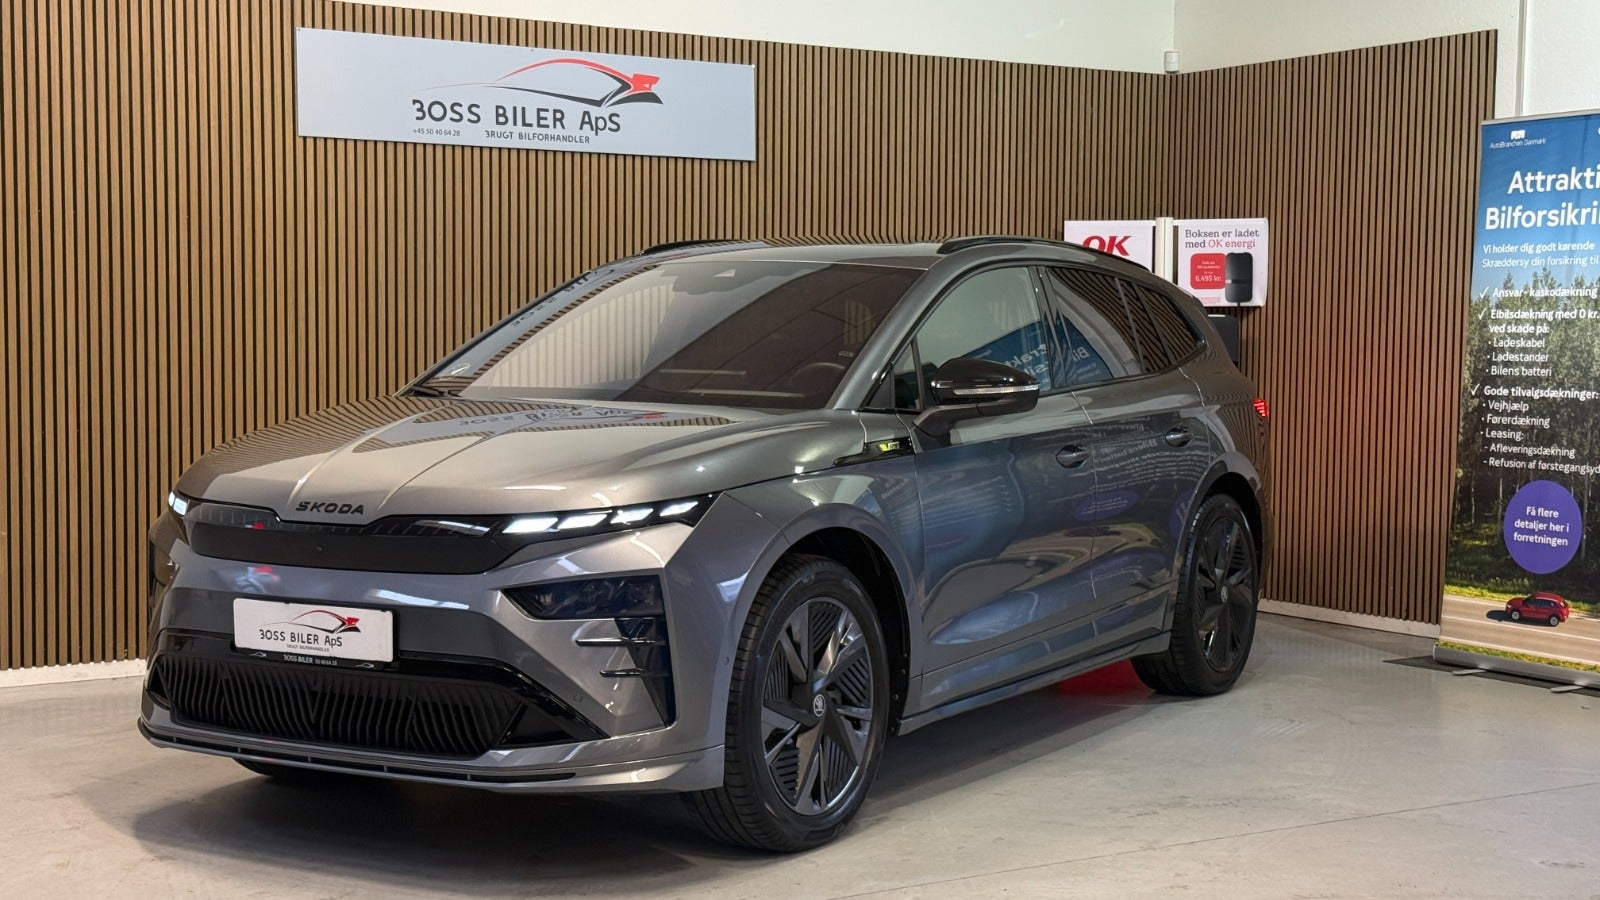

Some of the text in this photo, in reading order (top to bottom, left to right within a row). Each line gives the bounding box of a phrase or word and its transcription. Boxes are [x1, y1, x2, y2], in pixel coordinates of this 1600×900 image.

[495, 105, 566, 130] BILER
[579, 111, 621, 136] ApS
[435, 128, 443, 136] 40
[518, 132, 590, 144] BILFORHANDLER
[1485, 200, 1600, 230] Bilforsikri
[1185, 229, 1220, 238] Boksen
[1235, 229, 1260, 238] ladet
[1082, 235, 1132, 256] OK
[1185, 239, 1256, 249] med OK energi
[1483, 241, 1595, 254] Vi holder dig godt kørende
[1482, 255, 1599, 268] Skræddersy din forsikring til
[1529, 287, 1598, 299] kaskodækning
[1490, 310, 1553, 321] Elbilsdækning
[1555, 310, 1576, 319] med
[1580, 310, 1586, 319] 0
[1489, 324, 1550, 335] ved skade på:
[1493, 338, 1545, 348] Ladeskabel
[1492, 353, 1549, 362] Ladestander
[1491, 366, 1552, 377] Bilens batteri
[1484, 386, 1599, 401] Gode tilvalgsdækninger:
[1488, 400, 1529, 412] Vejhjælp
[1486, 414, 1550, 428] Førerdækning
[1486, 428, 1524, 441] Leasing:
[1490, 443, 1576, 459] Afleveringsdækning
[1488, 458, 1527, 469] Refusion
[1528, 458, 1536, 469] af
[1526, 506, 1559, 518] Få flere
[1514, 519, 1547, 533] detaljer
[1549, 521, 1565, 532] her
[1513, 532, 1568, 547] forretningen
[290, 632, 319, 645] BILER
[324, 635, 343, 648] ApS
